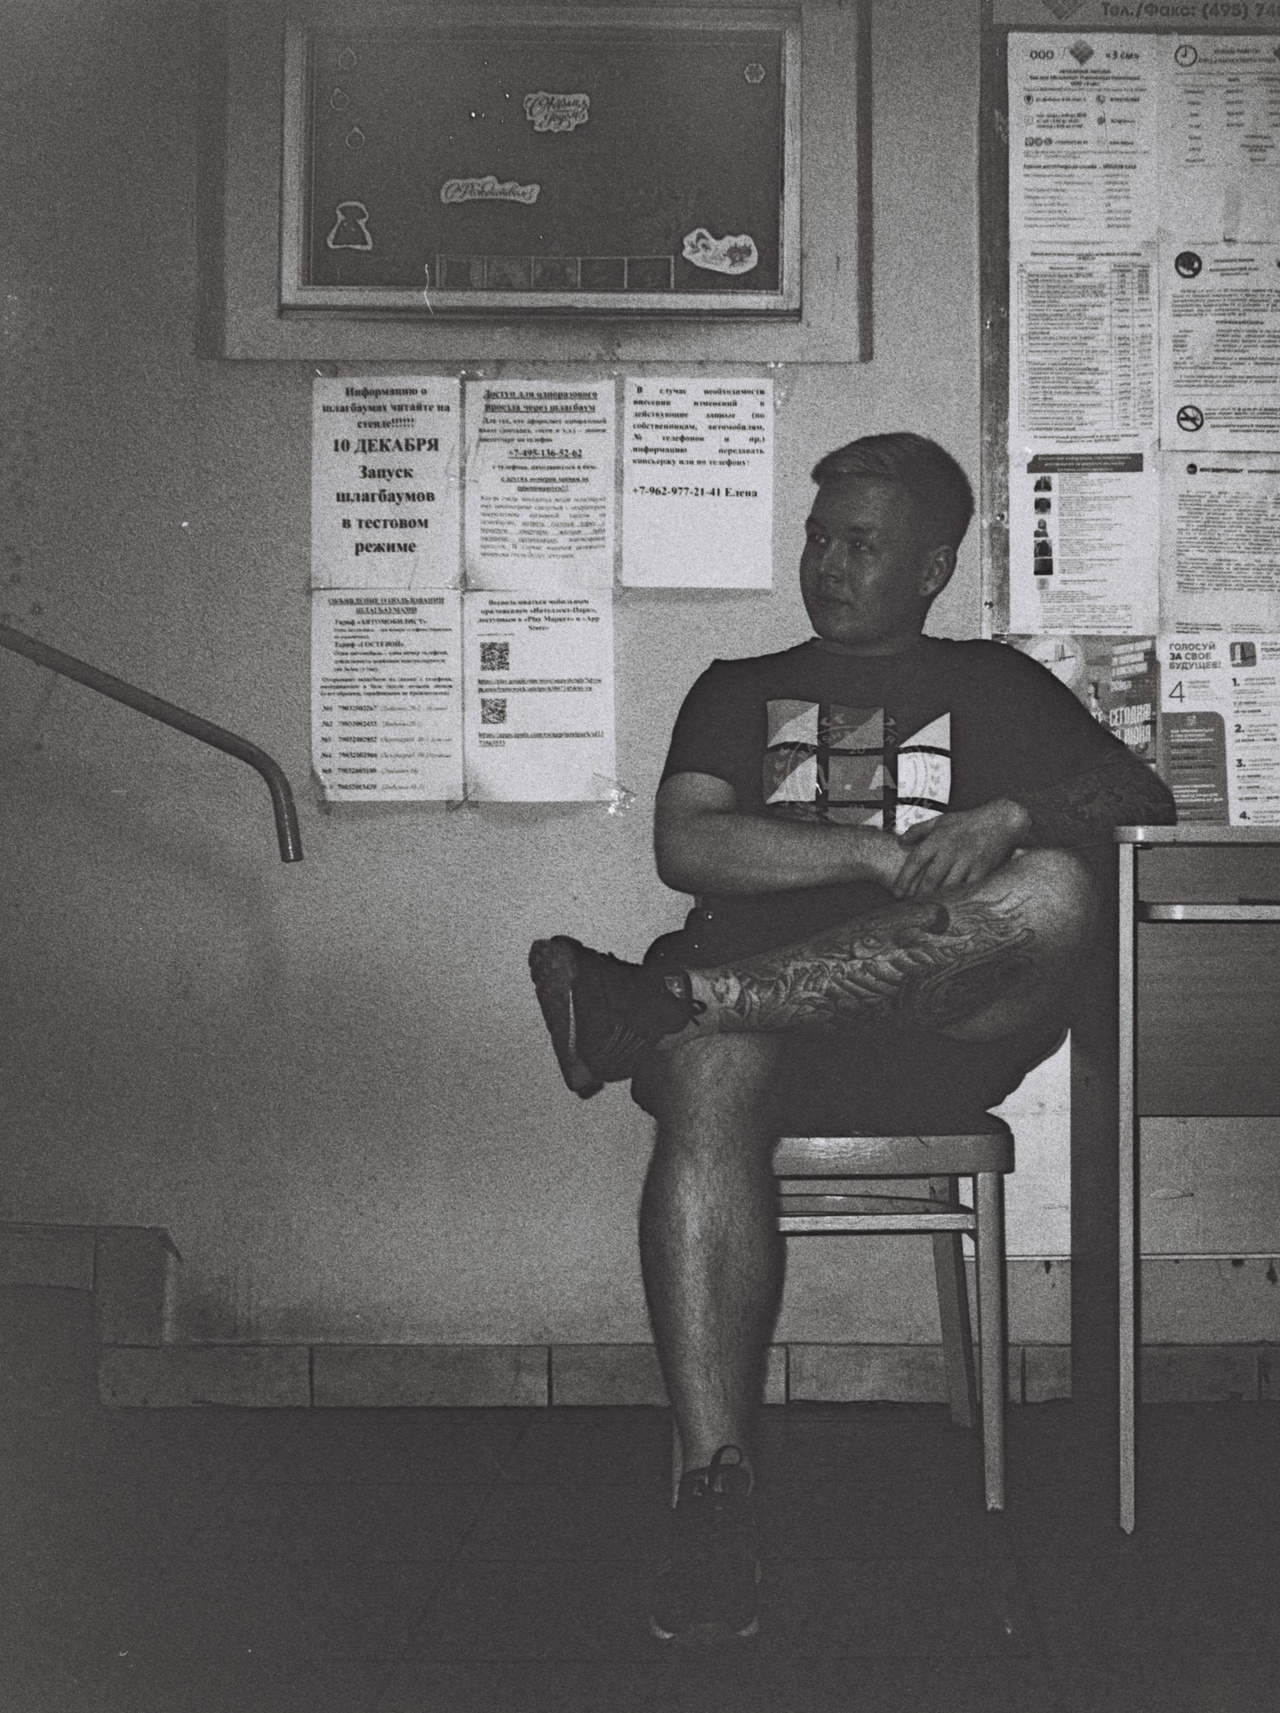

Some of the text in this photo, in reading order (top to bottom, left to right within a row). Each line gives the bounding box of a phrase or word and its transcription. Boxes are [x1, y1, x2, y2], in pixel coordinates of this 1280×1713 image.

[1200, 1, 1250, 20] (495)
[344, 386, 428, 399] Информацию о
[659, 388, 687, 396] случае
[703, 387, 766, 396] необходимости
[321, 403, 451, 415] шлагбаумах читайте на
[333, 437, 440, 455] 10 ДЕКАБРЯ
[358, 465, 414, 482] Запуск
[335, 488, 436, 506] шлагбаумов
[633, 486, 758, 498] +7-962-977-21-41 Елена
[341, 517, 429, 529] в тестовом
[354, 541, 417, 557] режиме
[1168, 680, 1186, 704] 4
